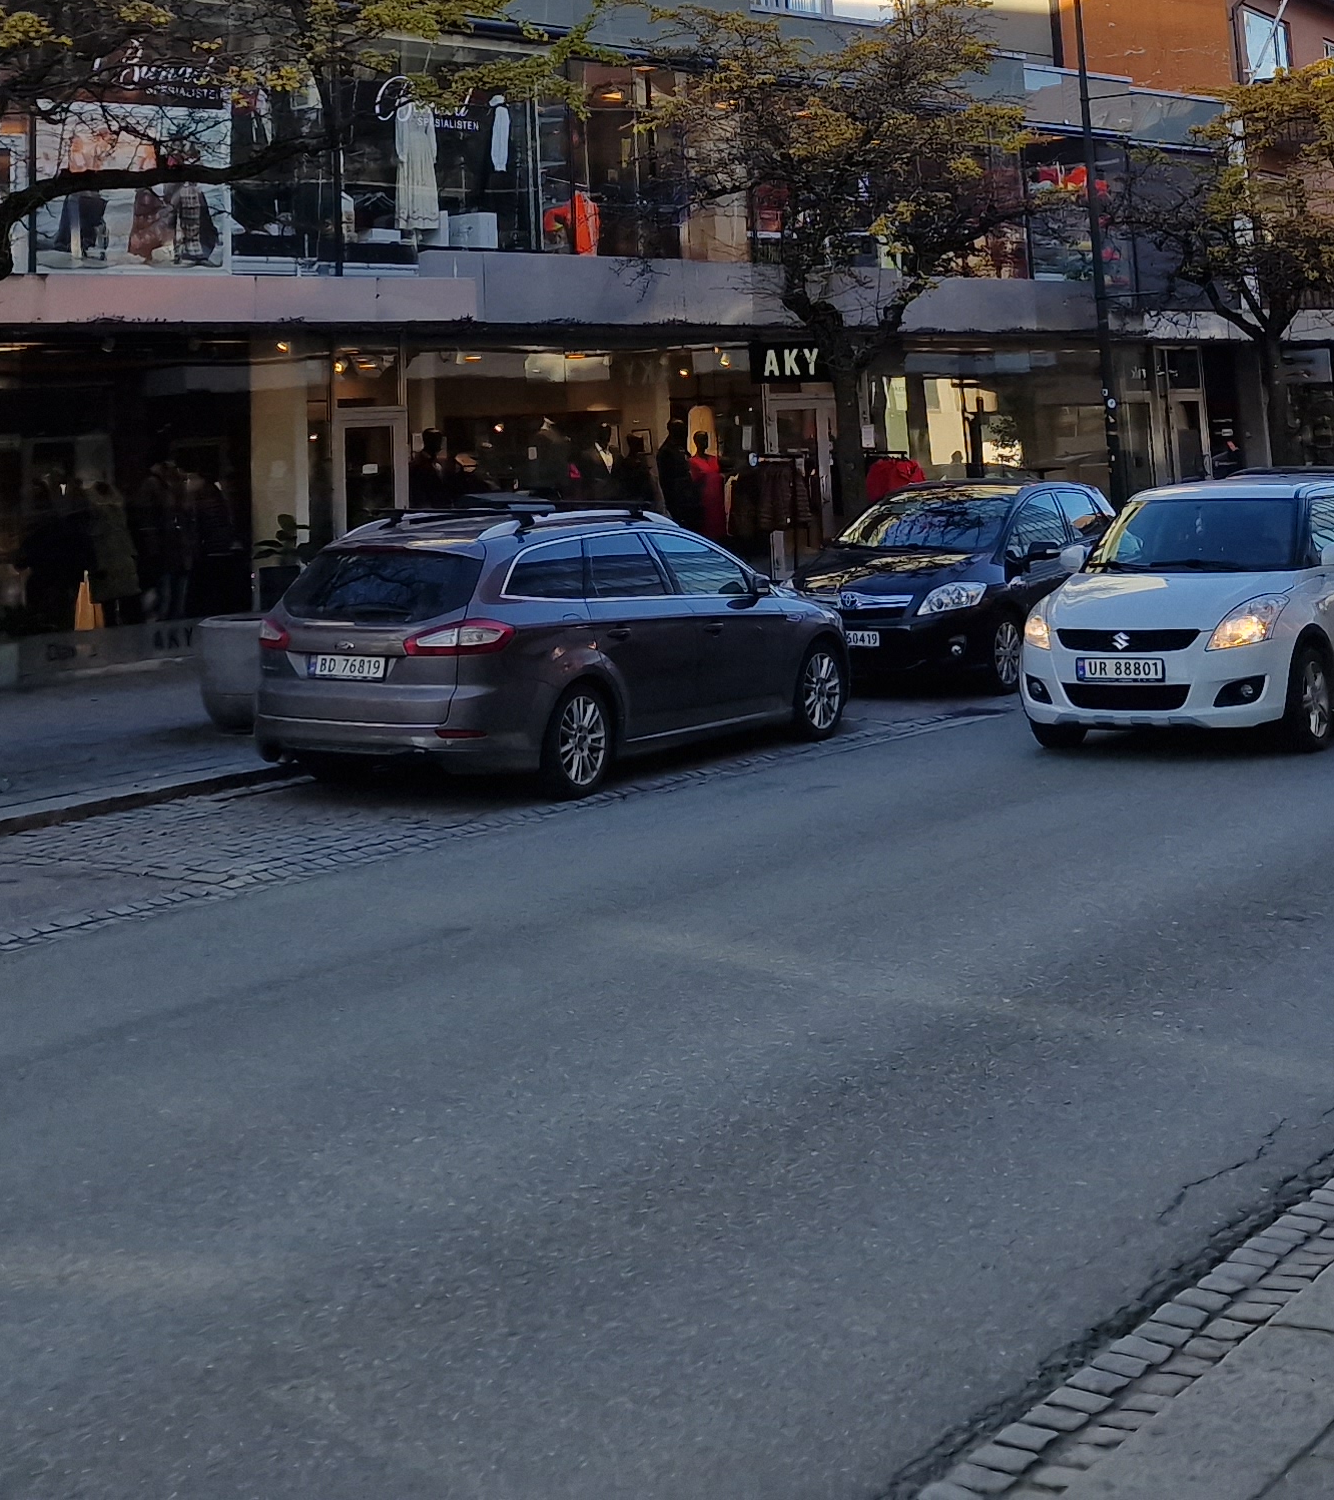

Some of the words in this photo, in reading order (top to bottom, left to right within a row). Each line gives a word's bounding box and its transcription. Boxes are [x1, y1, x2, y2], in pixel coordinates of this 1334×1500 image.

[764, 348, 819, 376] AKY
[319, 657, 337, 673] BD
[342, 658, 381, 675] 76819
[1088, 661, 1108, 676] UR
[1114, 661, 1159, 676] 88801
